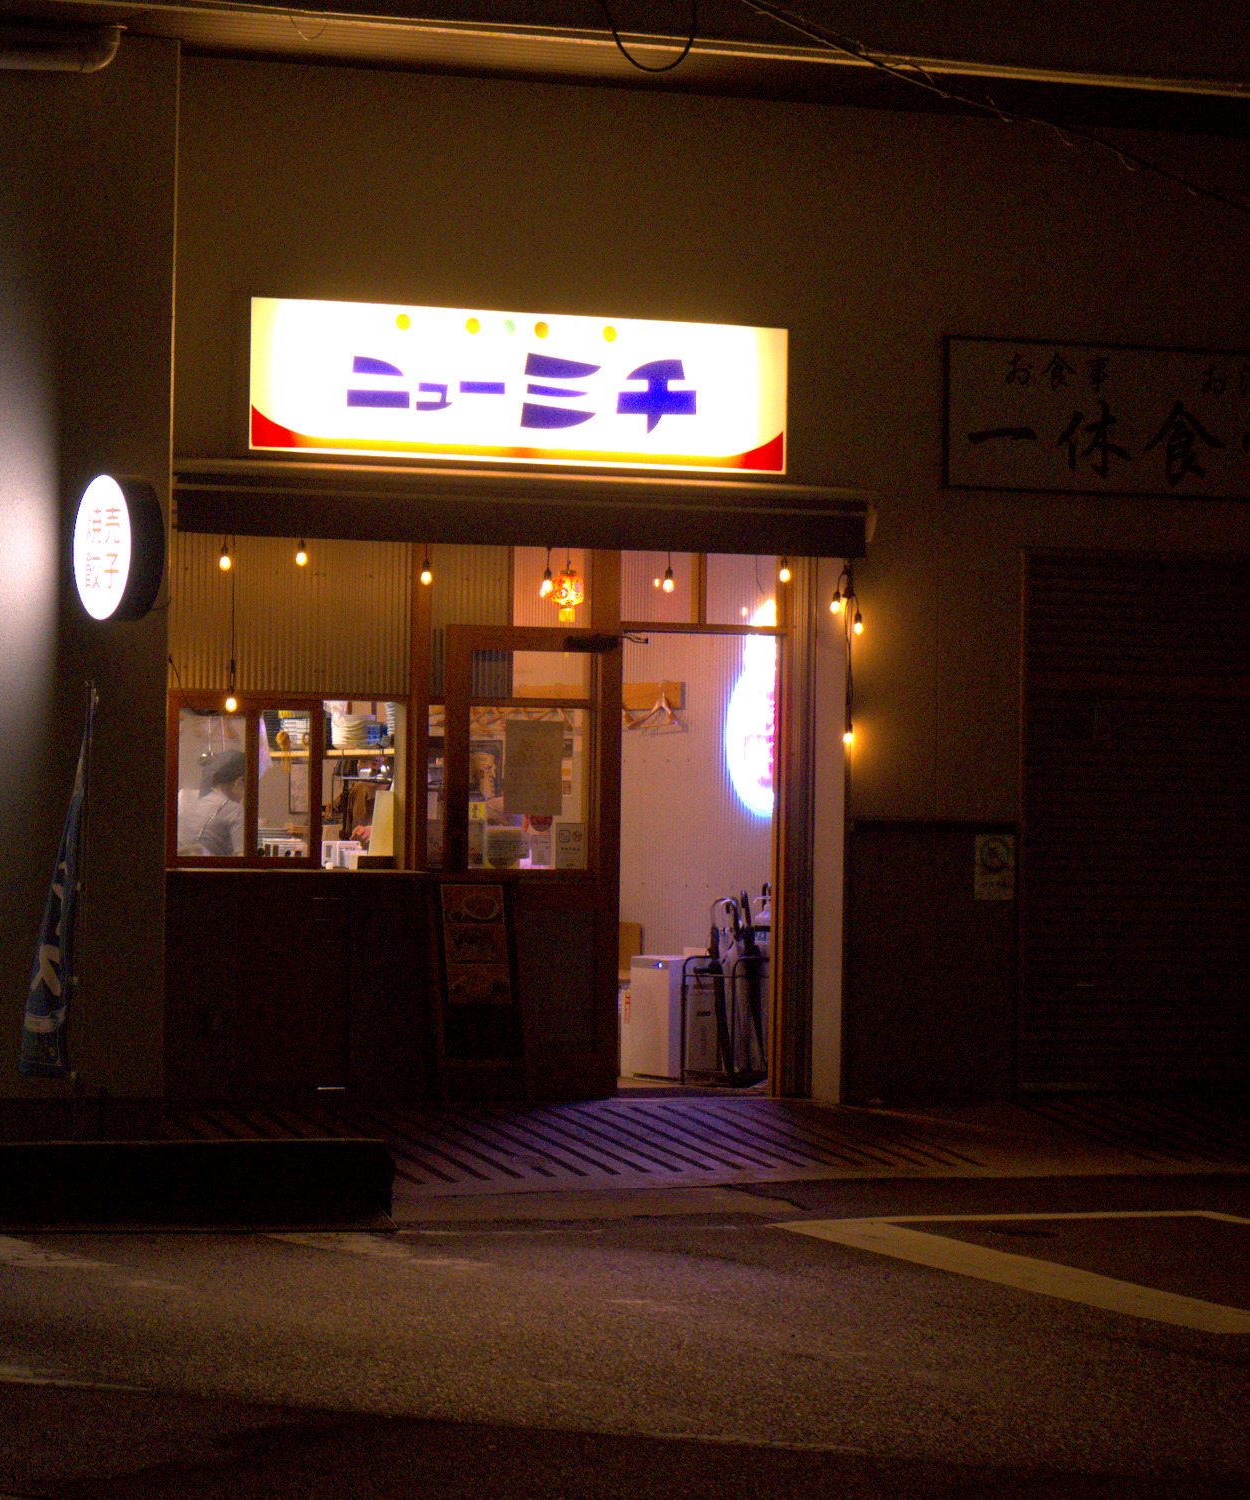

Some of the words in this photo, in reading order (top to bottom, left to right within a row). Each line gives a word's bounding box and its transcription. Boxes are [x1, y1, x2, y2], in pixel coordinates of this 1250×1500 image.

[347, 353, 696, 434] ニューミチ
[967, 399, 1250, 487] 一休食
